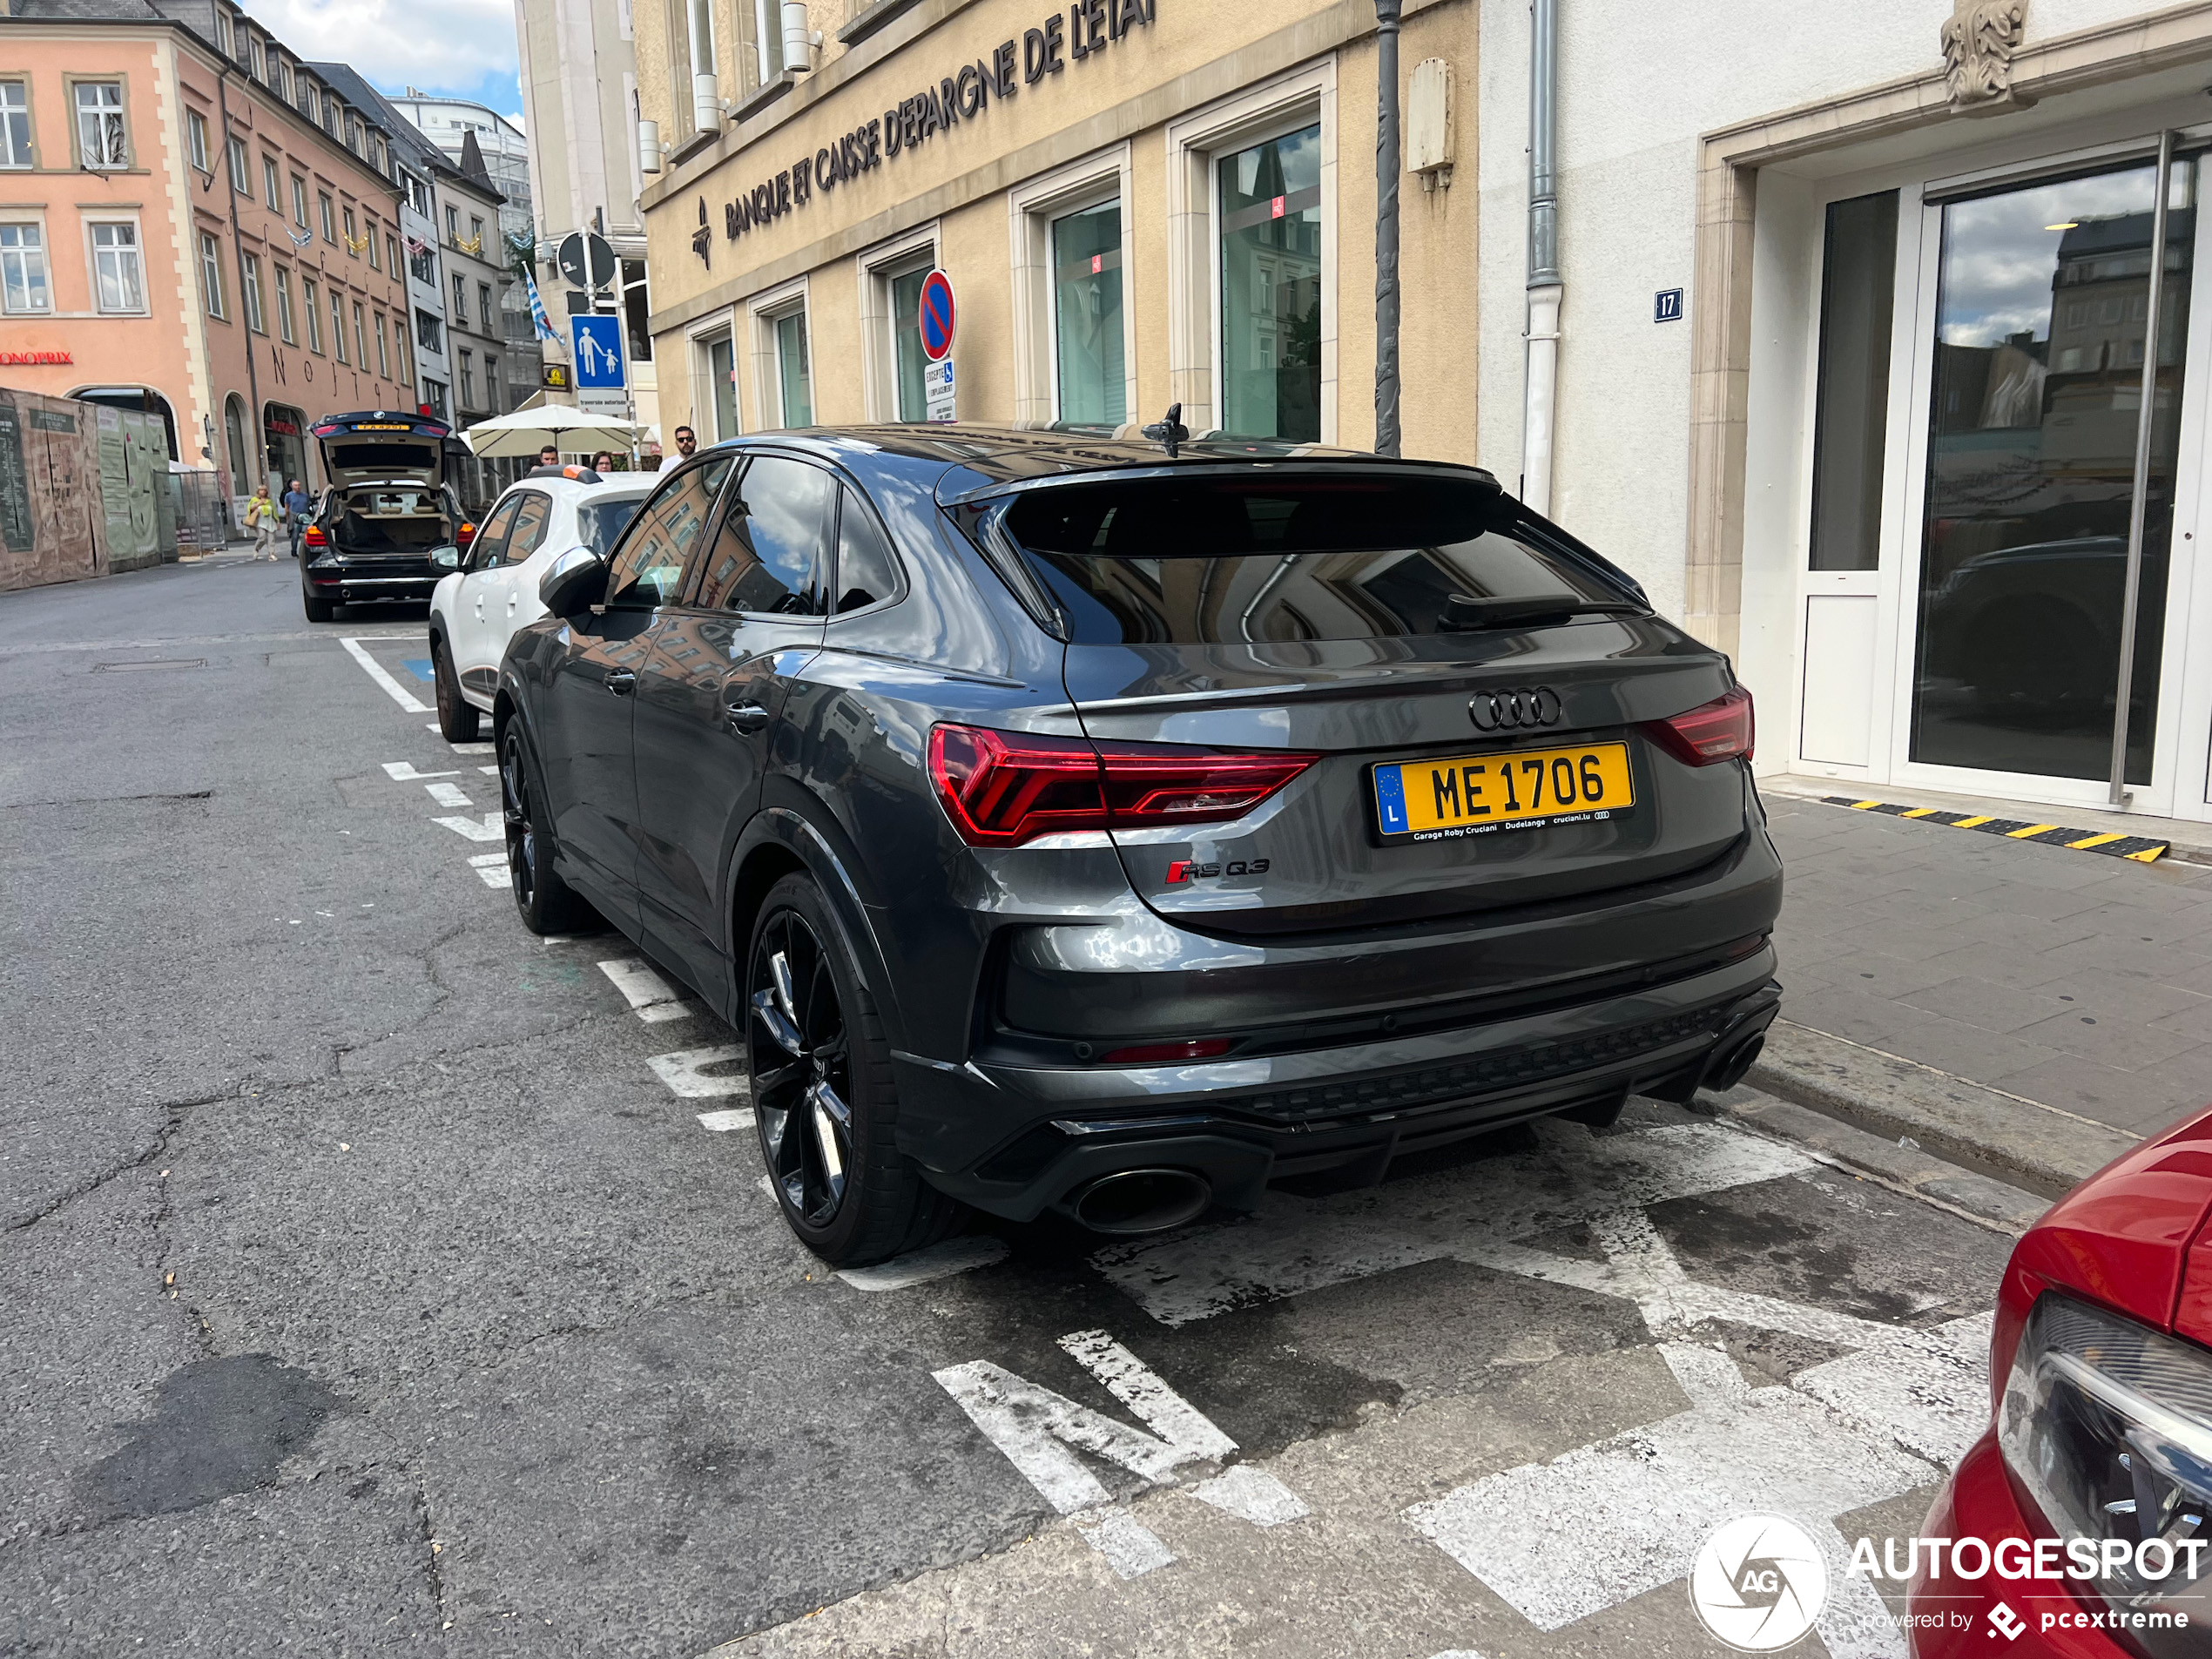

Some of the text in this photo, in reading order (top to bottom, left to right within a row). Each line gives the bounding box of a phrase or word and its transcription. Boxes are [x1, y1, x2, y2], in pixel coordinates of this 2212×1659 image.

[725, 170, 790, 239] BANQUE
[793, 158, 811, 206] ET
[815, 118, 880, 192] CAISSE
[885, 39, 1016, 158] D'EPARGNE
[1024, 13, 1064, 84] DE
[1662, 294, 1675, 316] 17
[1388, 754, 1604, 822] L ME 1706
[1413, 812, 1591, 841] Garage Roby Cruciani Dudelange cruciani.lu
[1176, 859, 1271, 879] RS Q3
